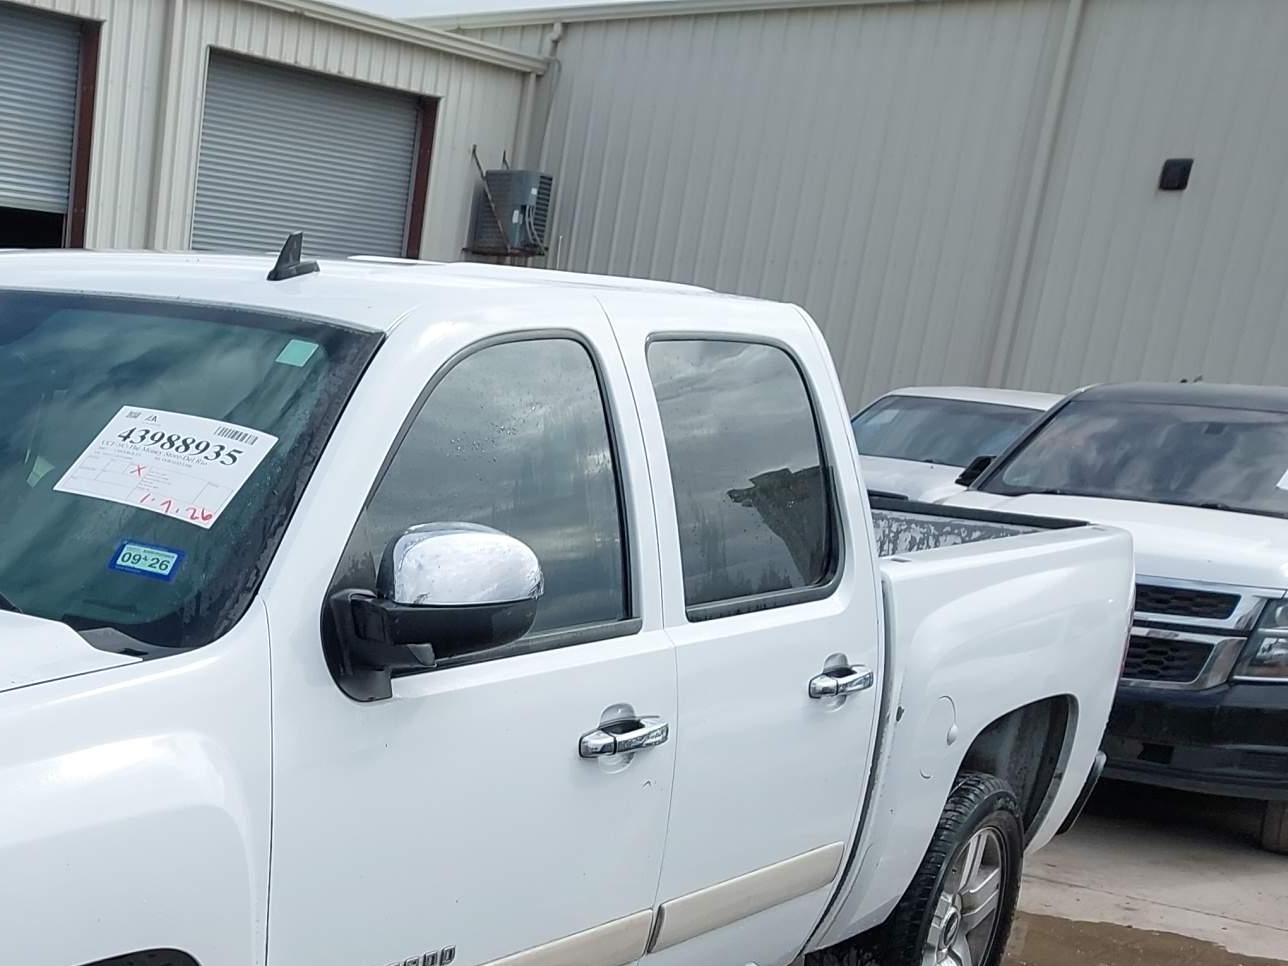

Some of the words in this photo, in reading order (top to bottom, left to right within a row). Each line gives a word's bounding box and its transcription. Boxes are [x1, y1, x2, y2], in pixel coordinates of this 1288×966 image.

[117, 426, 245, 466] 43988935
[121, 551, 142, 565] 09
[147, 557, 171, 571] 26
